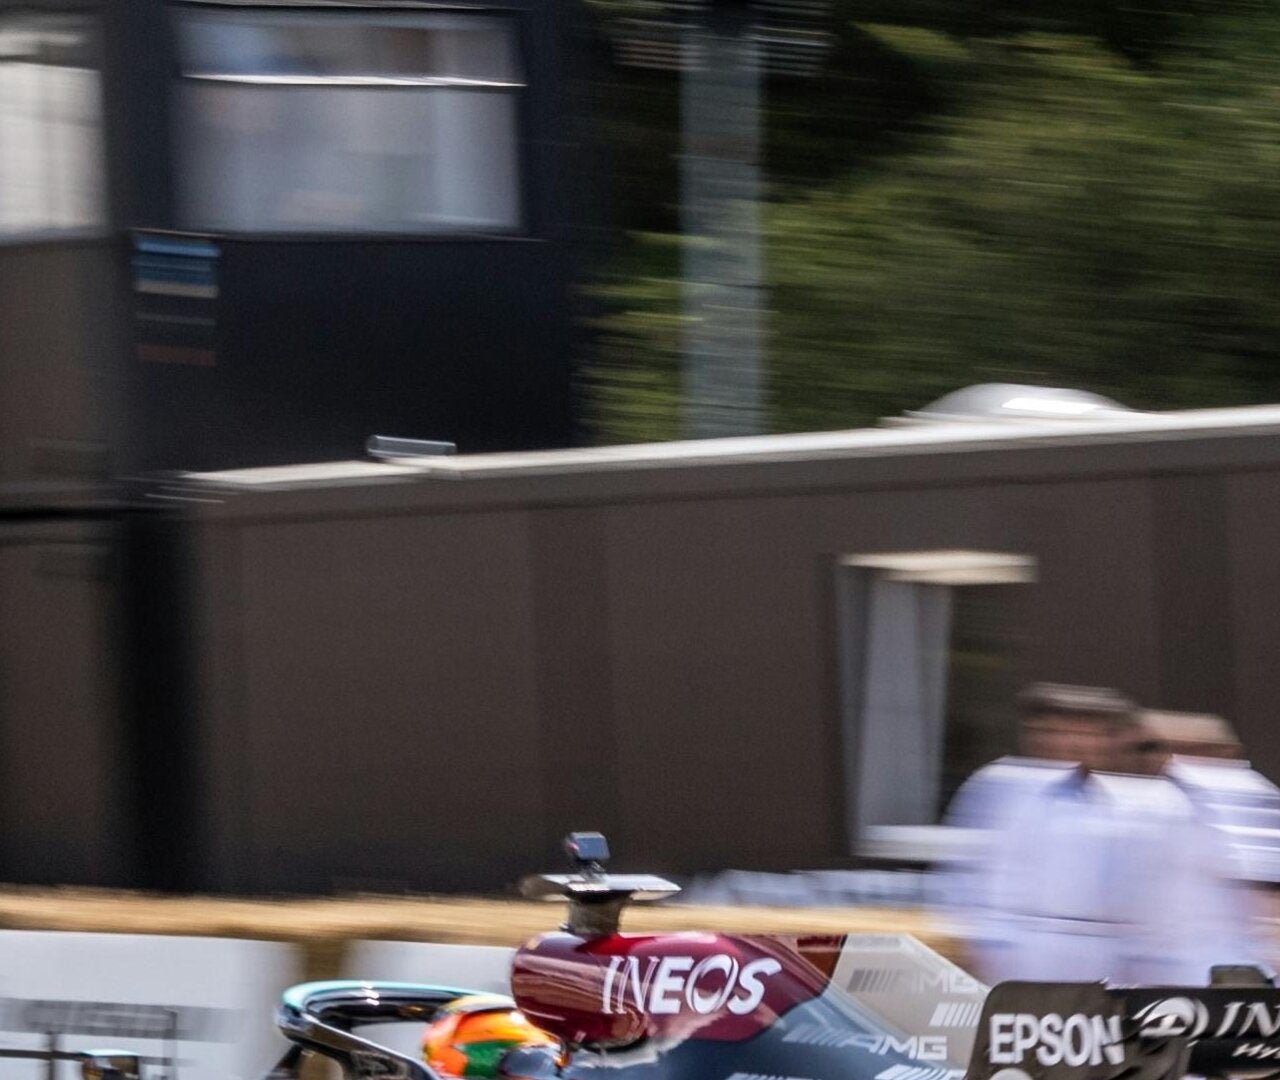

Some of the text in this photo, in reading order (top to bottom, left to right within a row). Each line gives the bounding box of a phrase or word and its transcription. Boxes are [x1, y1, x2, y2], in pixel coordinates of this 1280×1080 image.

[601, 953, 783, 1015] INEOS
[836, 1031, 948, 1061] AMG
[989, 1012, 1125, 1067] EPSON
